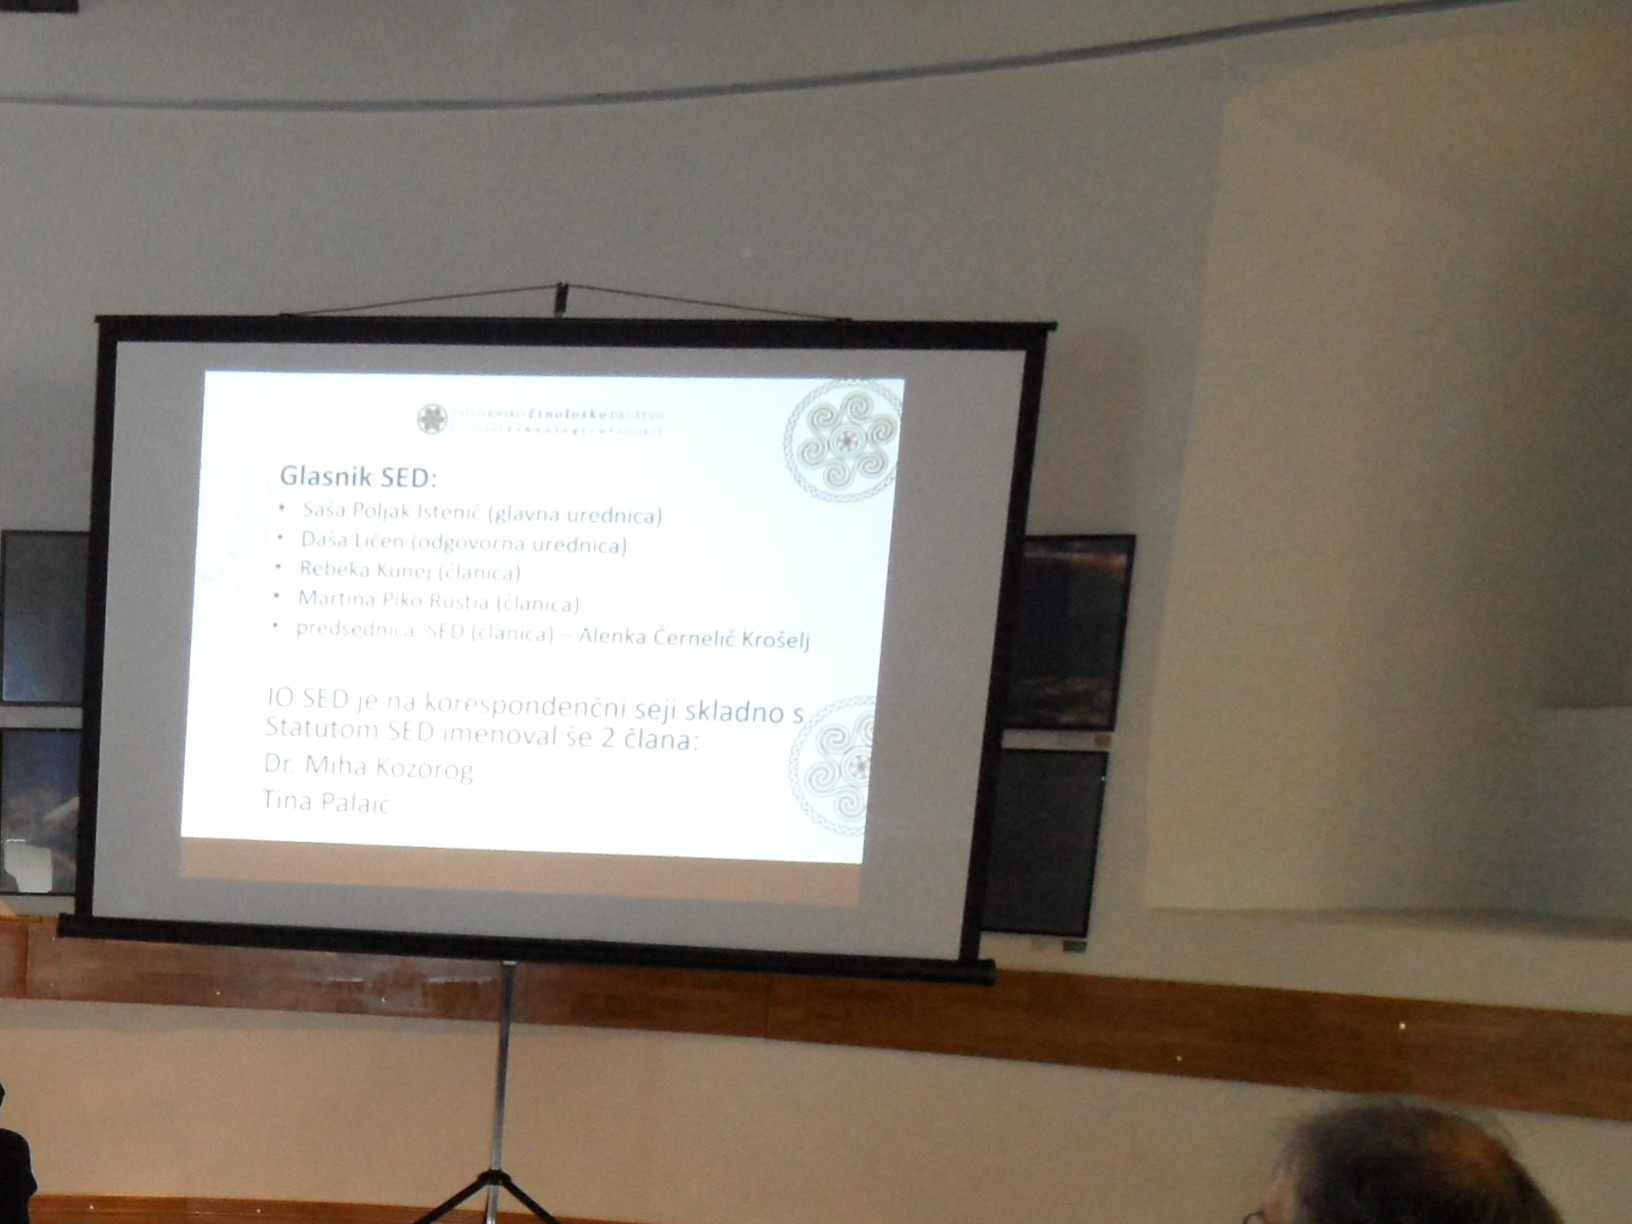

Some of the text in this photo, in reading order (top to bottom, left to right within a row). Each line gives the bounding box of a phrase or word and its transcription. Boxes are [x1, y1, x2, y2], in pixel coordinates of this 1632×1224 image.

[280, 464, 437, 488] Glasnik SED:
[353, 501, 410, 523] Poljak
[488, 503, 560, 526] (glavna
[567, 506, 663, 529] urednica)
[411, 533, 524, 555] (odgovorna
[533, 536, 627, 558] urednica)
[300, 559, 521, 584] Rebeka Kunej (članica)
[298, 588, 580, 617] Martina Piko Rustia (članica)
[296, 620, 415, 639] predsednica
[428, 622, 464, 639] SED
[471, 623, 554, 645] (članica)
[579, 626, 647, 645] Alenka
[742, 629, 811, 653] Krošelj
[268, 685, 805, 726] IO SED je na korespondenčni seji skladno s
[266, 715, 699, 751] Statutom SED imenoval še 2 člana:
[264, 752, 474, 786] Dr. Miha Kozorog
[262, 788, 312, 811] Tina
